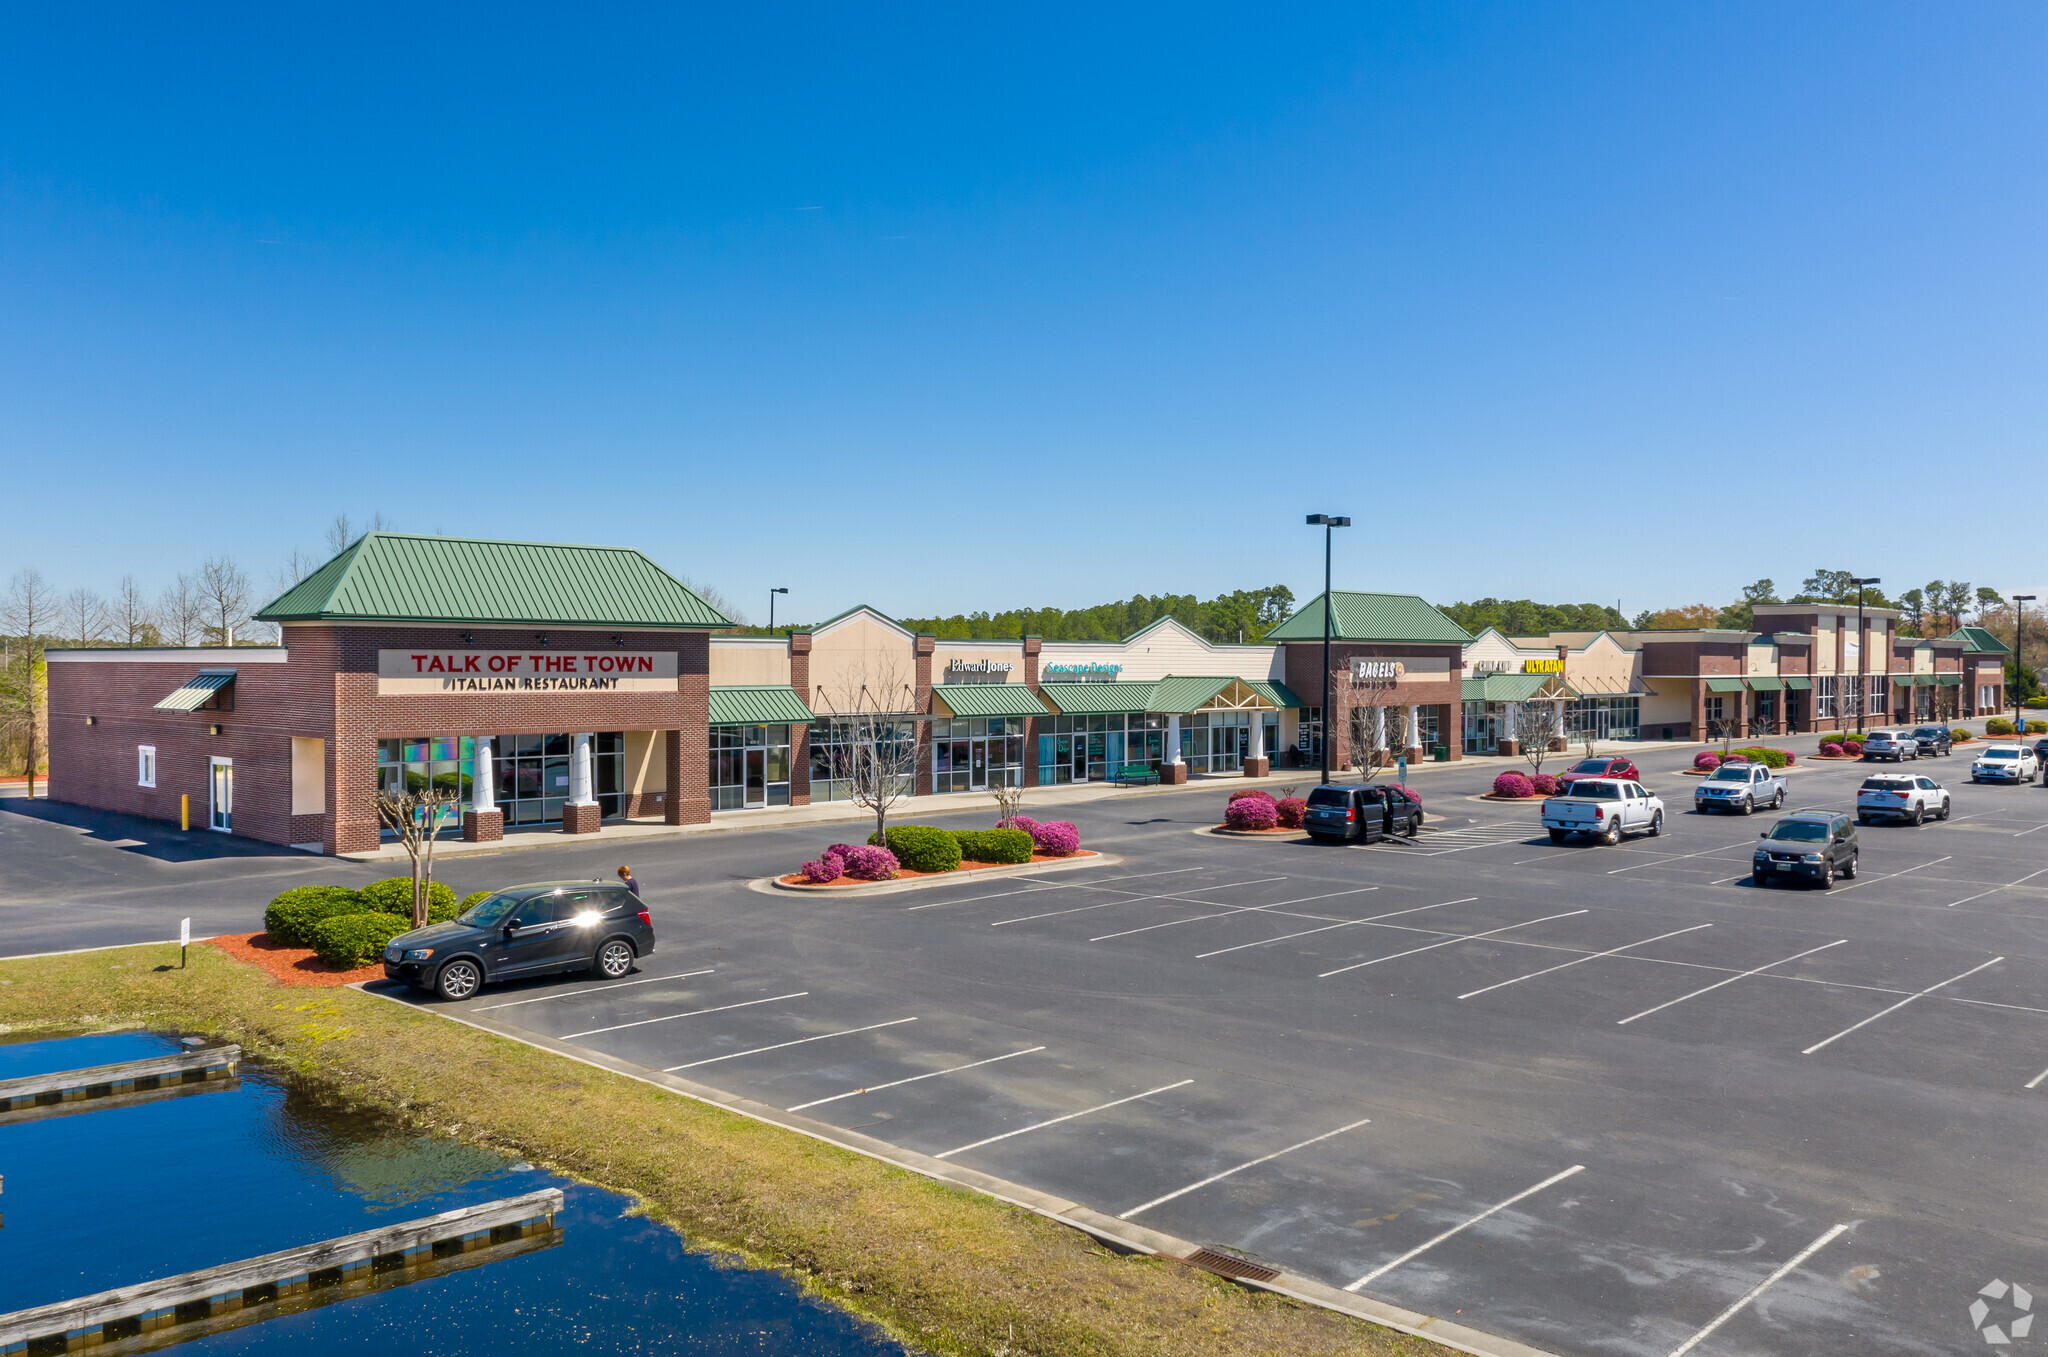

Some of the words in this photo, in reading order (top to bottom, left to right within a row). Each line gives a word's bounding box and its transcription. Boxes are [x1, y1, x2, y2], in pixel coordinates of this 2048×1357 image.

[411, 654, 481, 673] TALK
[488, 655, 522, 673] OF
[529, 655, 577, 673] THE
[583, 655, 653, 673] TOWN
[1048, 661, 1089, 676] Seascape
[1091, 661, 1123, 676] Designs
[1359, 661, 1396, 678] BAGELS
[1525, 659, 1564, 673] ULTRATAN
[451, 677, 516, 691] ITALIAN
[524, 677, 620, 690] RESTAURANT
